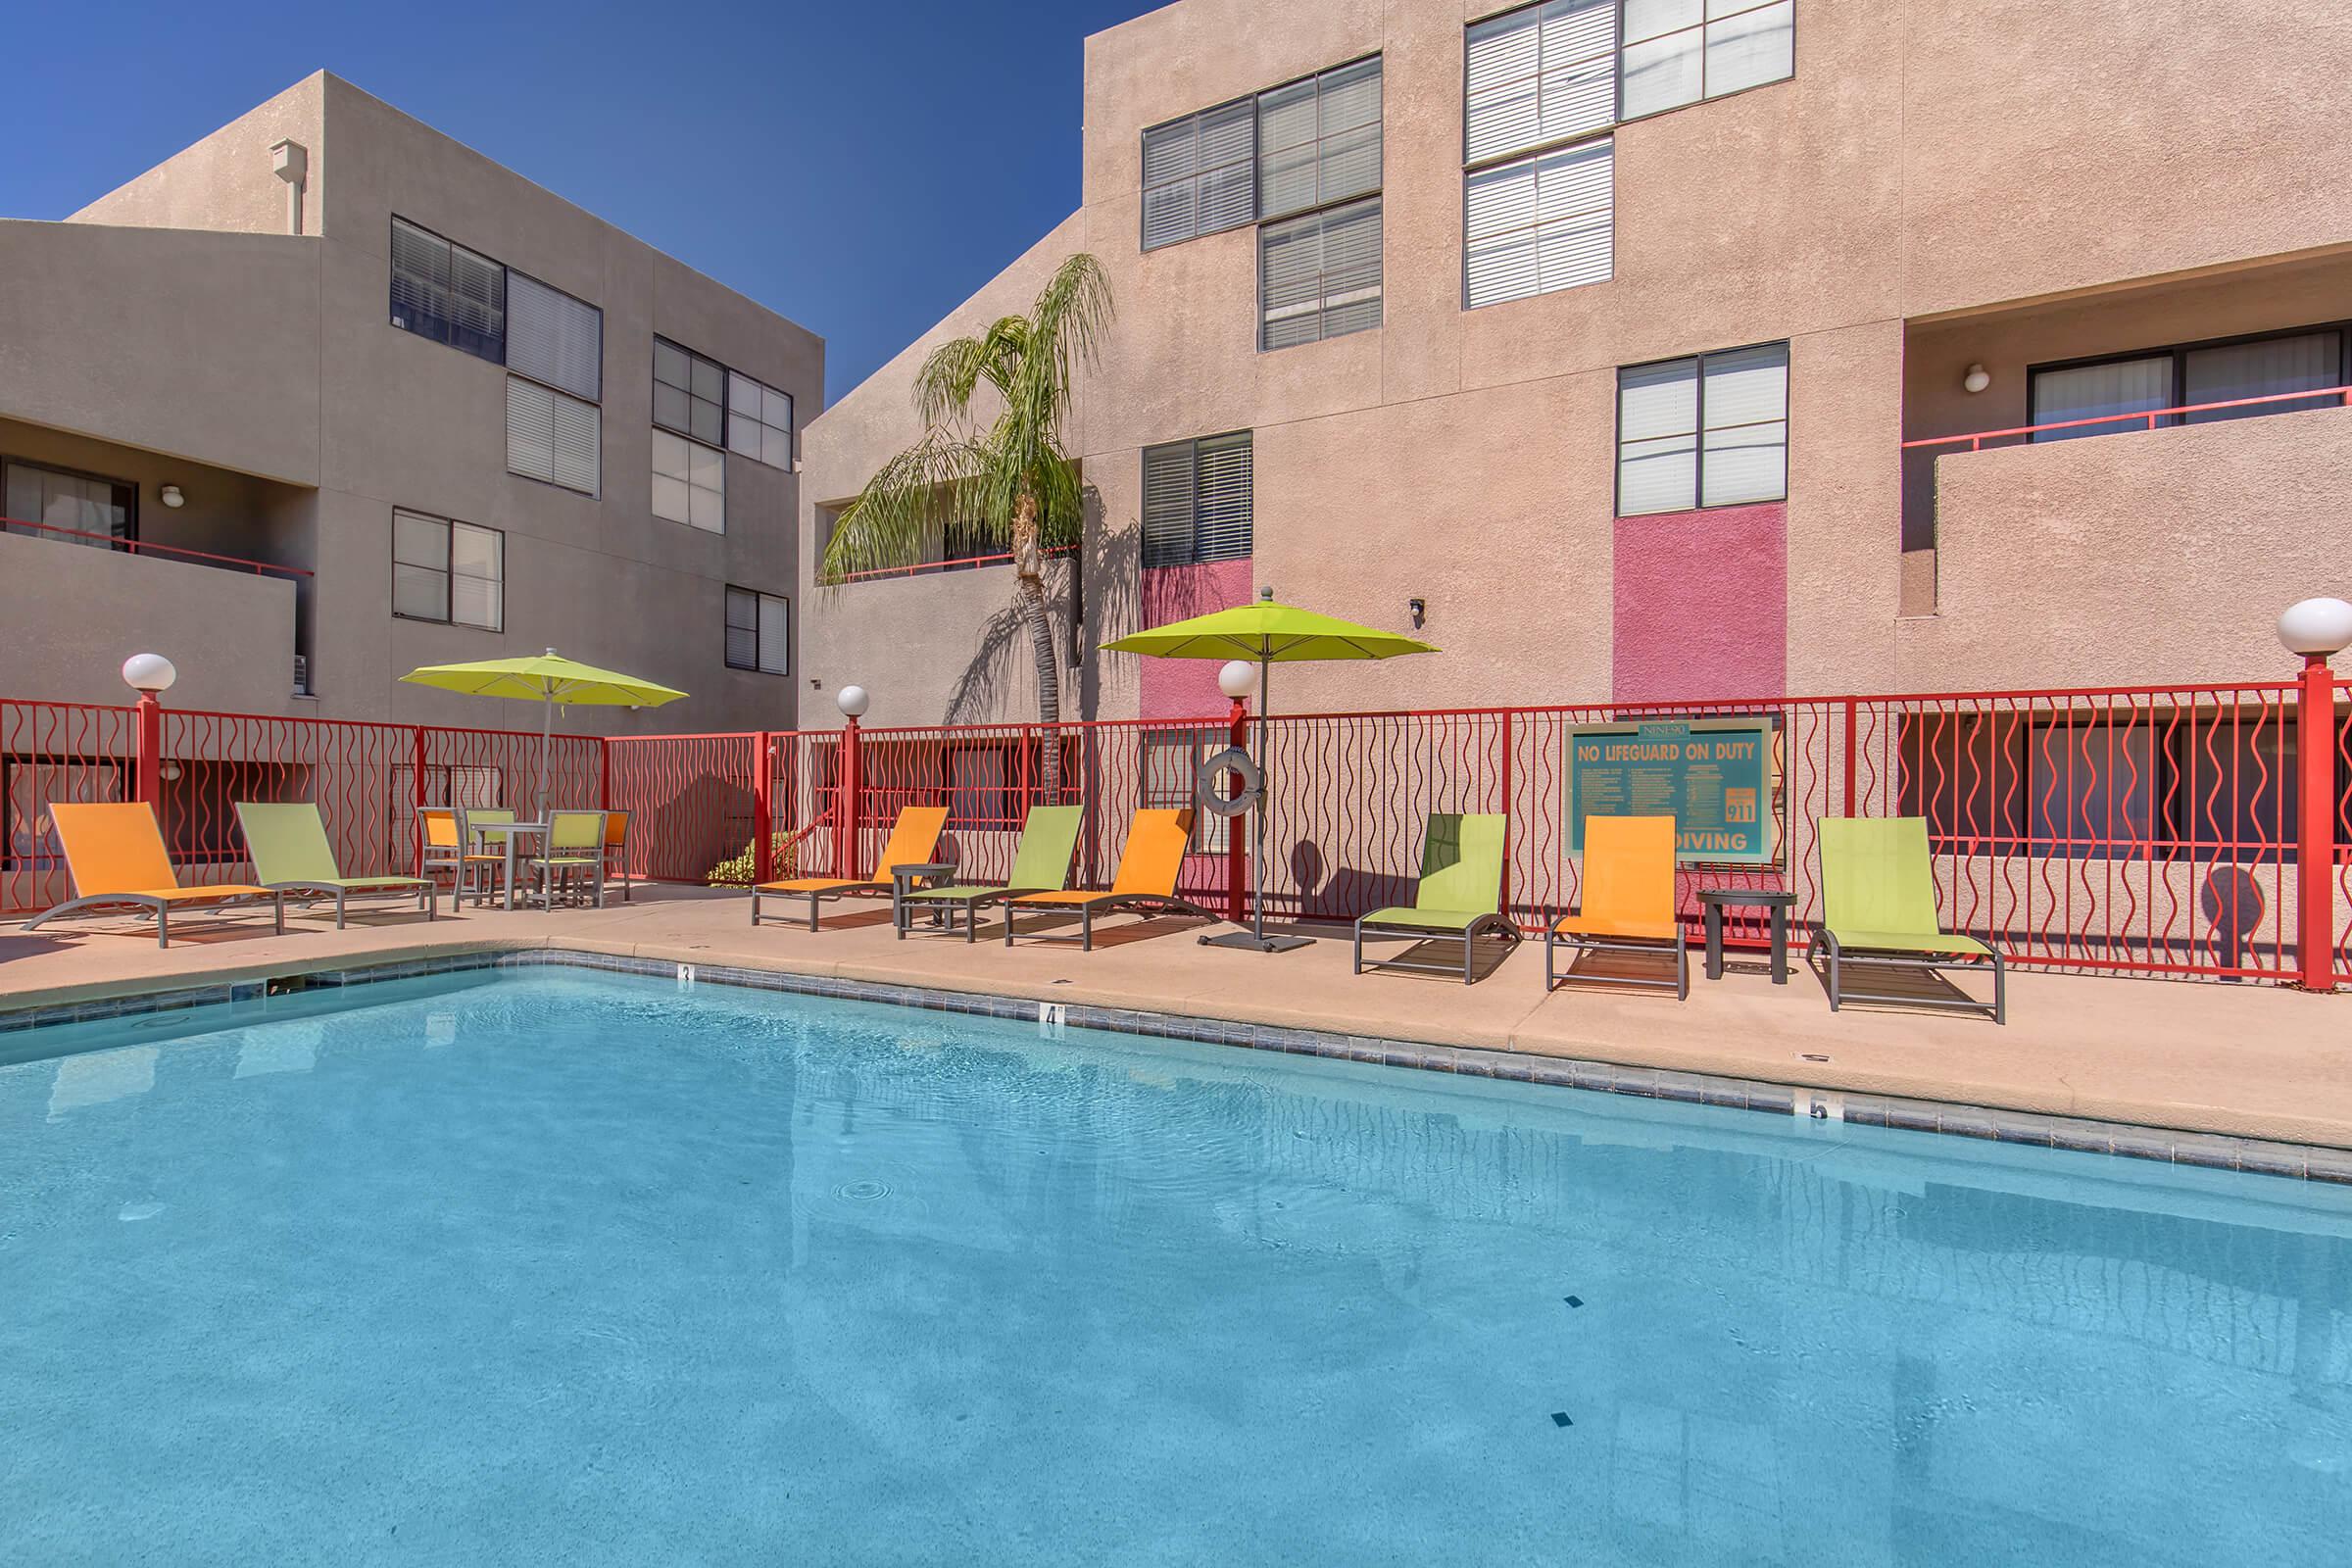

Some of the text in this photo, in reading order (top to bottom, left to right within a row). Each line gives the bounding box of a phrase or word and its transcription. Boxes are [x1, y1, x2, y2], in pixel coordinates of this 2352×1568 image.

[1578, 742, 1755, 761] NO LIFEGUARD ON DUTY
[1728, 805, 1753, 821] 911
[1047, 1005, 1057, 1024] 4
[1810, 1097, 1829, 1119] 5
